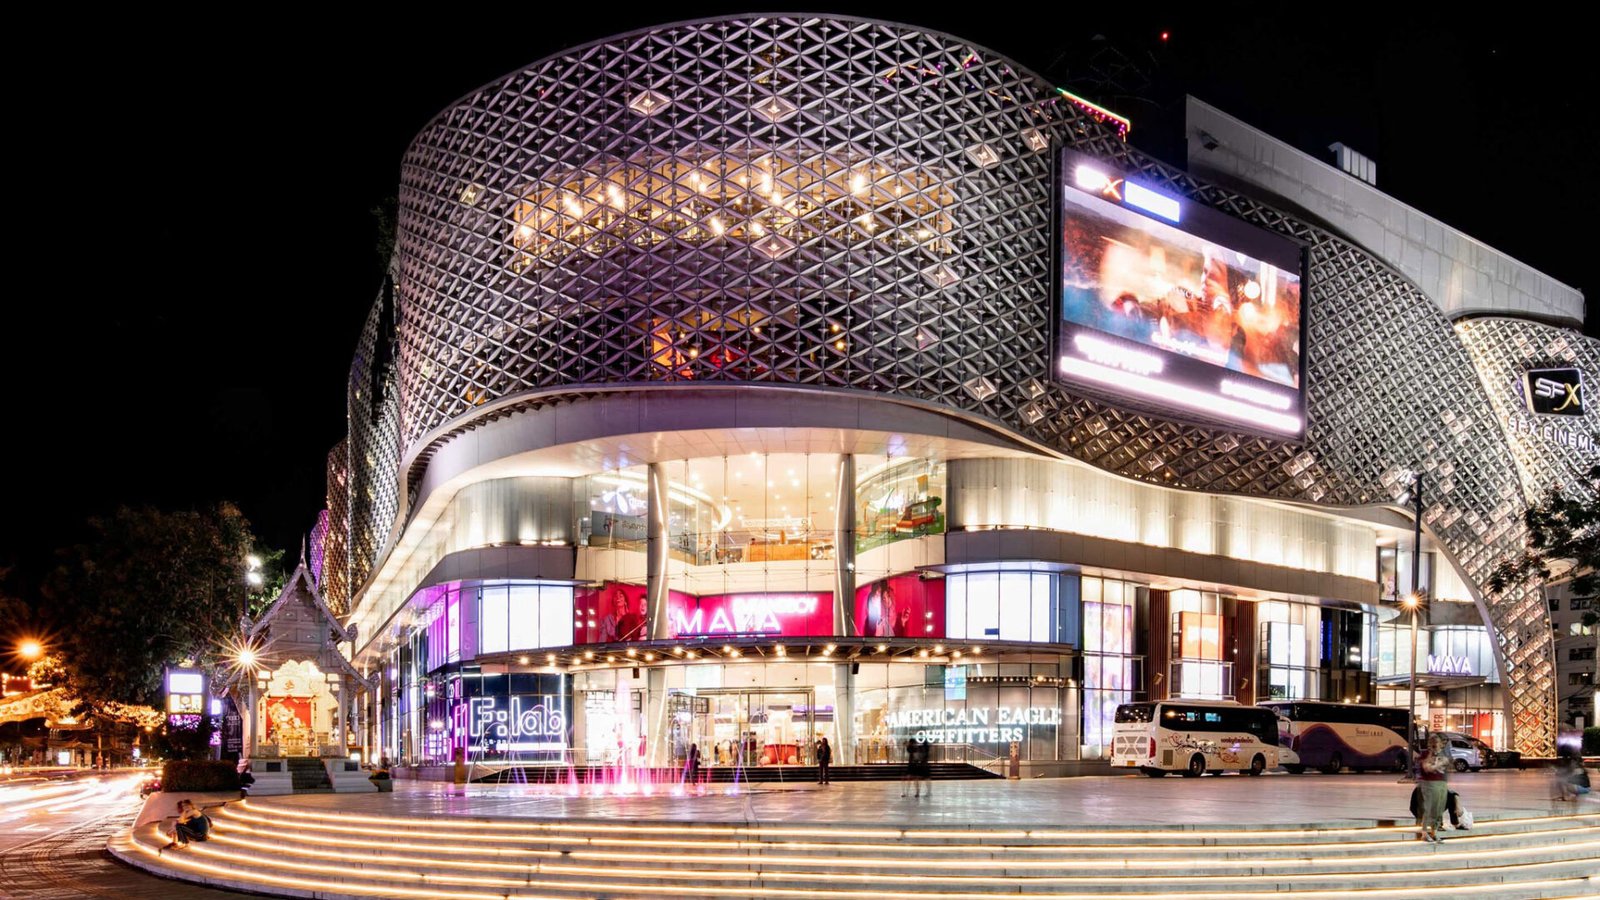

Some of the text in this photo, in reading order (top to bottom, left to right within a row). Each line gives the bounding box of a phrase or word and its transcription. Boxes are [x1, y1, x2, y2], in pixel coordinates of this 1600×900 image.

[1535, 377, 1581, 411] SFX
[1508, 416, 1537, 435] SFX
[1428, 654, 1471, 673] MAYA
[469, 695, 565, 736] F:lab
[887, 707, 1062, 728] AMERICAN EAGLE
[916, 728, 1023, 744] OUTFITTERS
